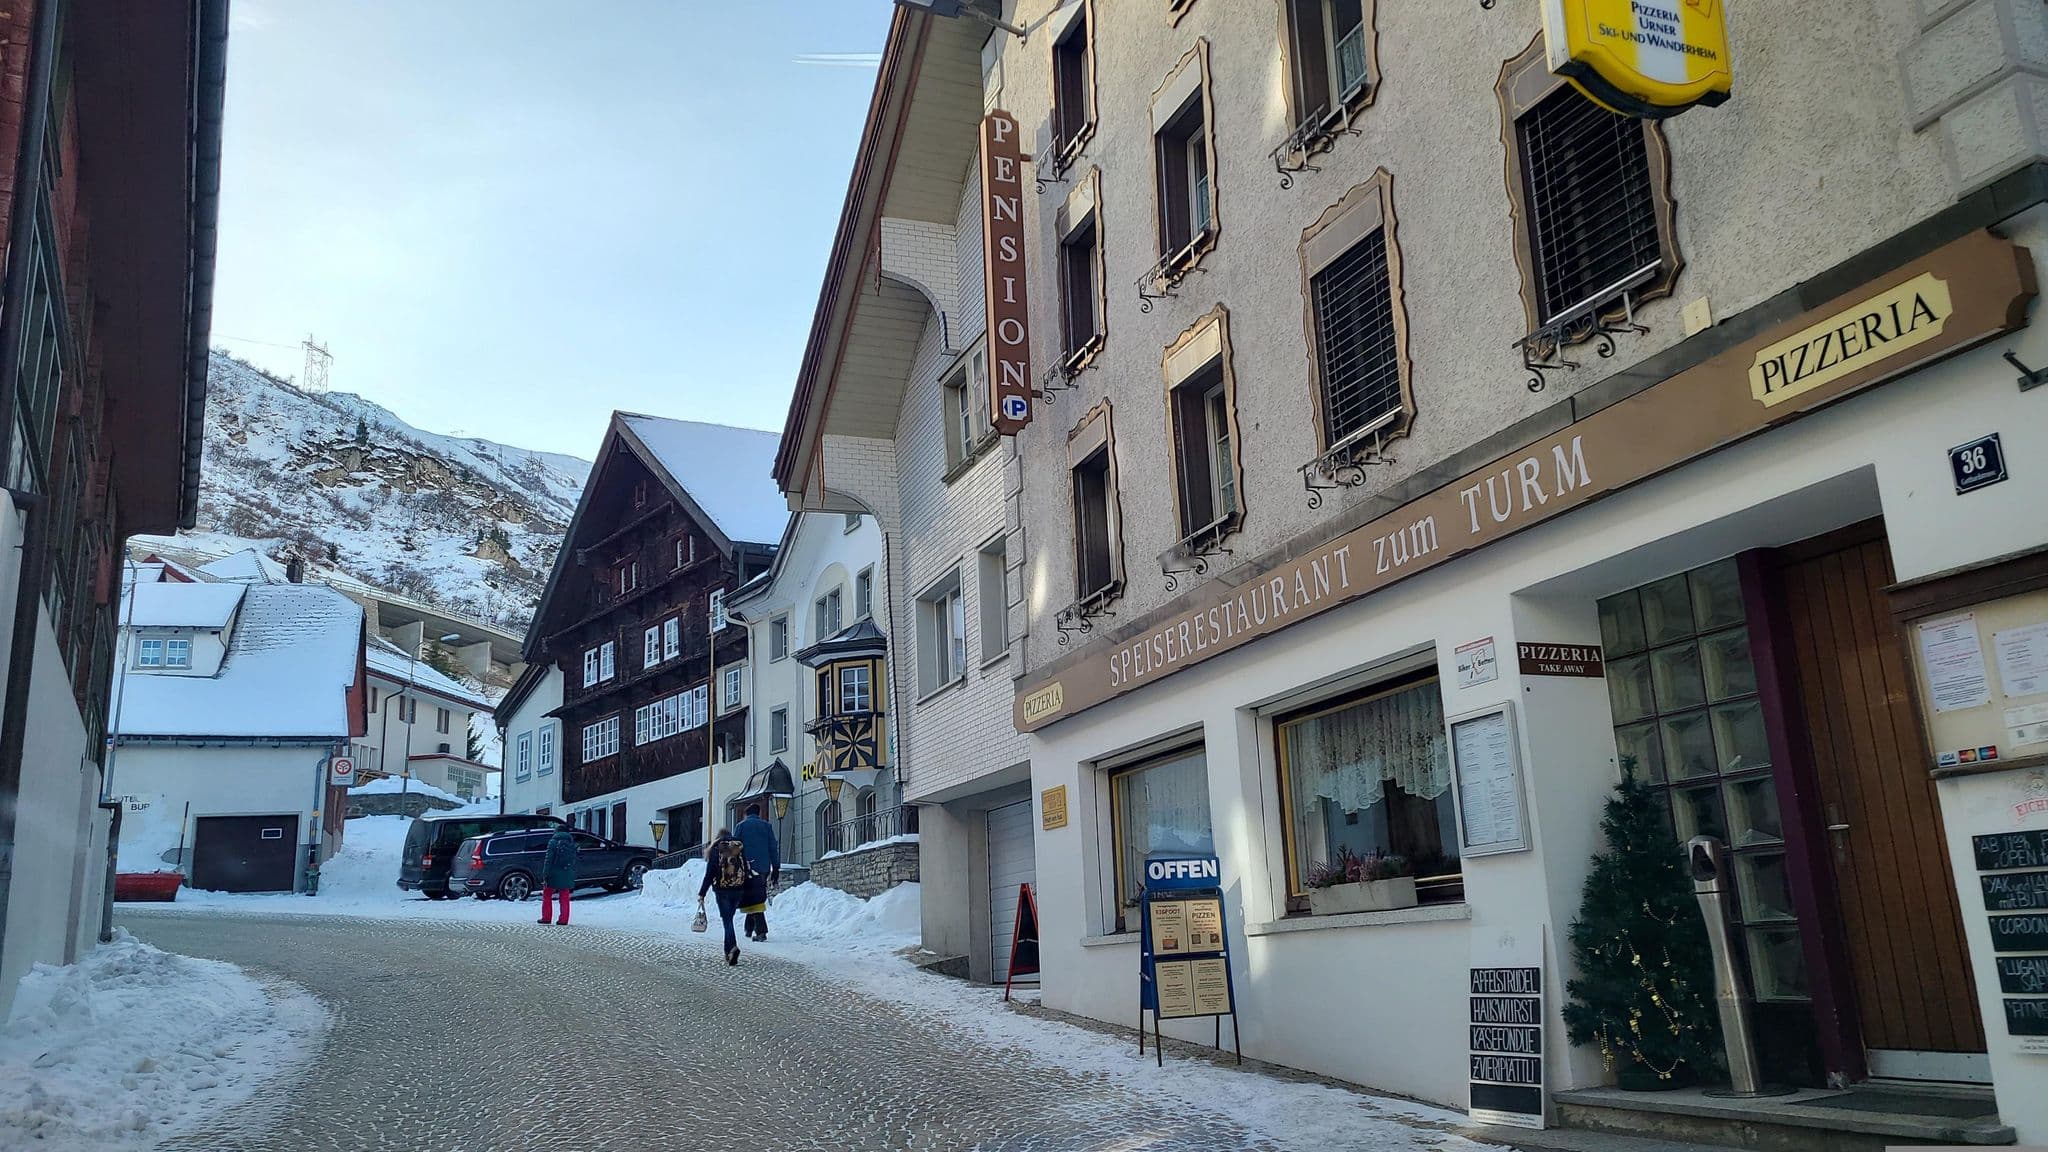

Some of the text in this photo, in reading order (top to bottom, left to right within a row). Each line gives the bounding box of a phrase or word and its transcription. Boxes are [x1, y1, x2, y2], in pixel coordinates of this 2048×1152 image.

[1631, 1, 1680, 23] PIZZERIA
[1639, 17, 1676, 36] URNER
[1622, 31, 1646, 44] UND
[1645, 34, 1717, 61] WANDERHEIM
[992, 116, 1026, 388] PENSION
[1758, 292, 1941, 395] PIZZERIA
[1960, 446, 1987, 474] 36
[1109, 435, 1592, 688] SPEISERESTAURANT zum TURM
[1519, 645, 1601, 662] PIZZERIA
[1538, 663, 1585, 674] TAKE AWAY
[1024, 688, 1061, 719] PIZZERIA
[1148, 859, 1218, 880] OFFEN
[1191, 911, 1216, 919] PIZZEN
[1471, 968, 1538, 993] APFELSTRUDEL
[1473, 998, 1535, 1023] HAUSWURST
[1472, 1026, 1537, 1053] KÄSEFONDUE
